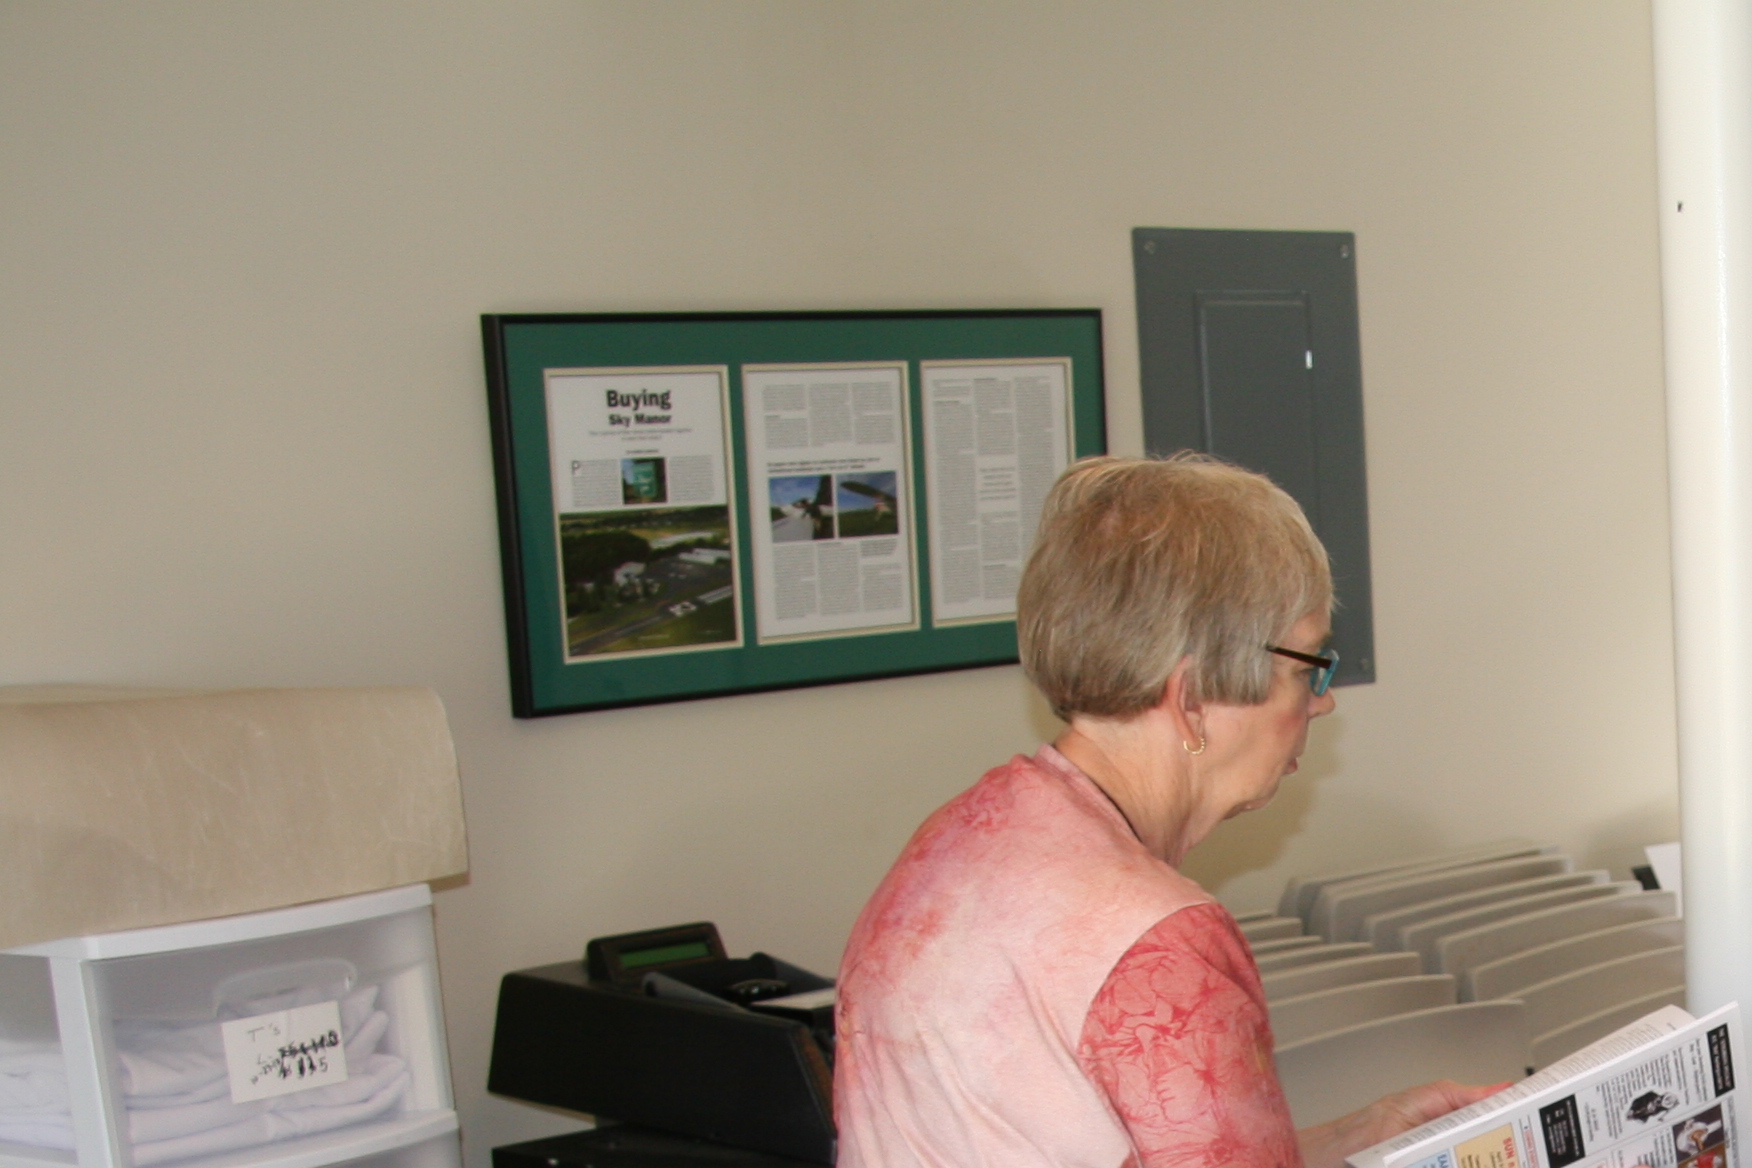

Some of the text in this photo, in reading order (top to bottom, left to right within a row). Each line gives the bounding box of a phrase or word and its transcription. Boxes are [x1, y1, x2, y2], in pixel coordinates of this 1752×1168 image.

[606, 389, 672, 411] Buying
[608, 413, 673, 428] Sky Manor
[1503, 1137, 1515, 1159] SUN
[1437, 1153, 1450, 1168] EAA
